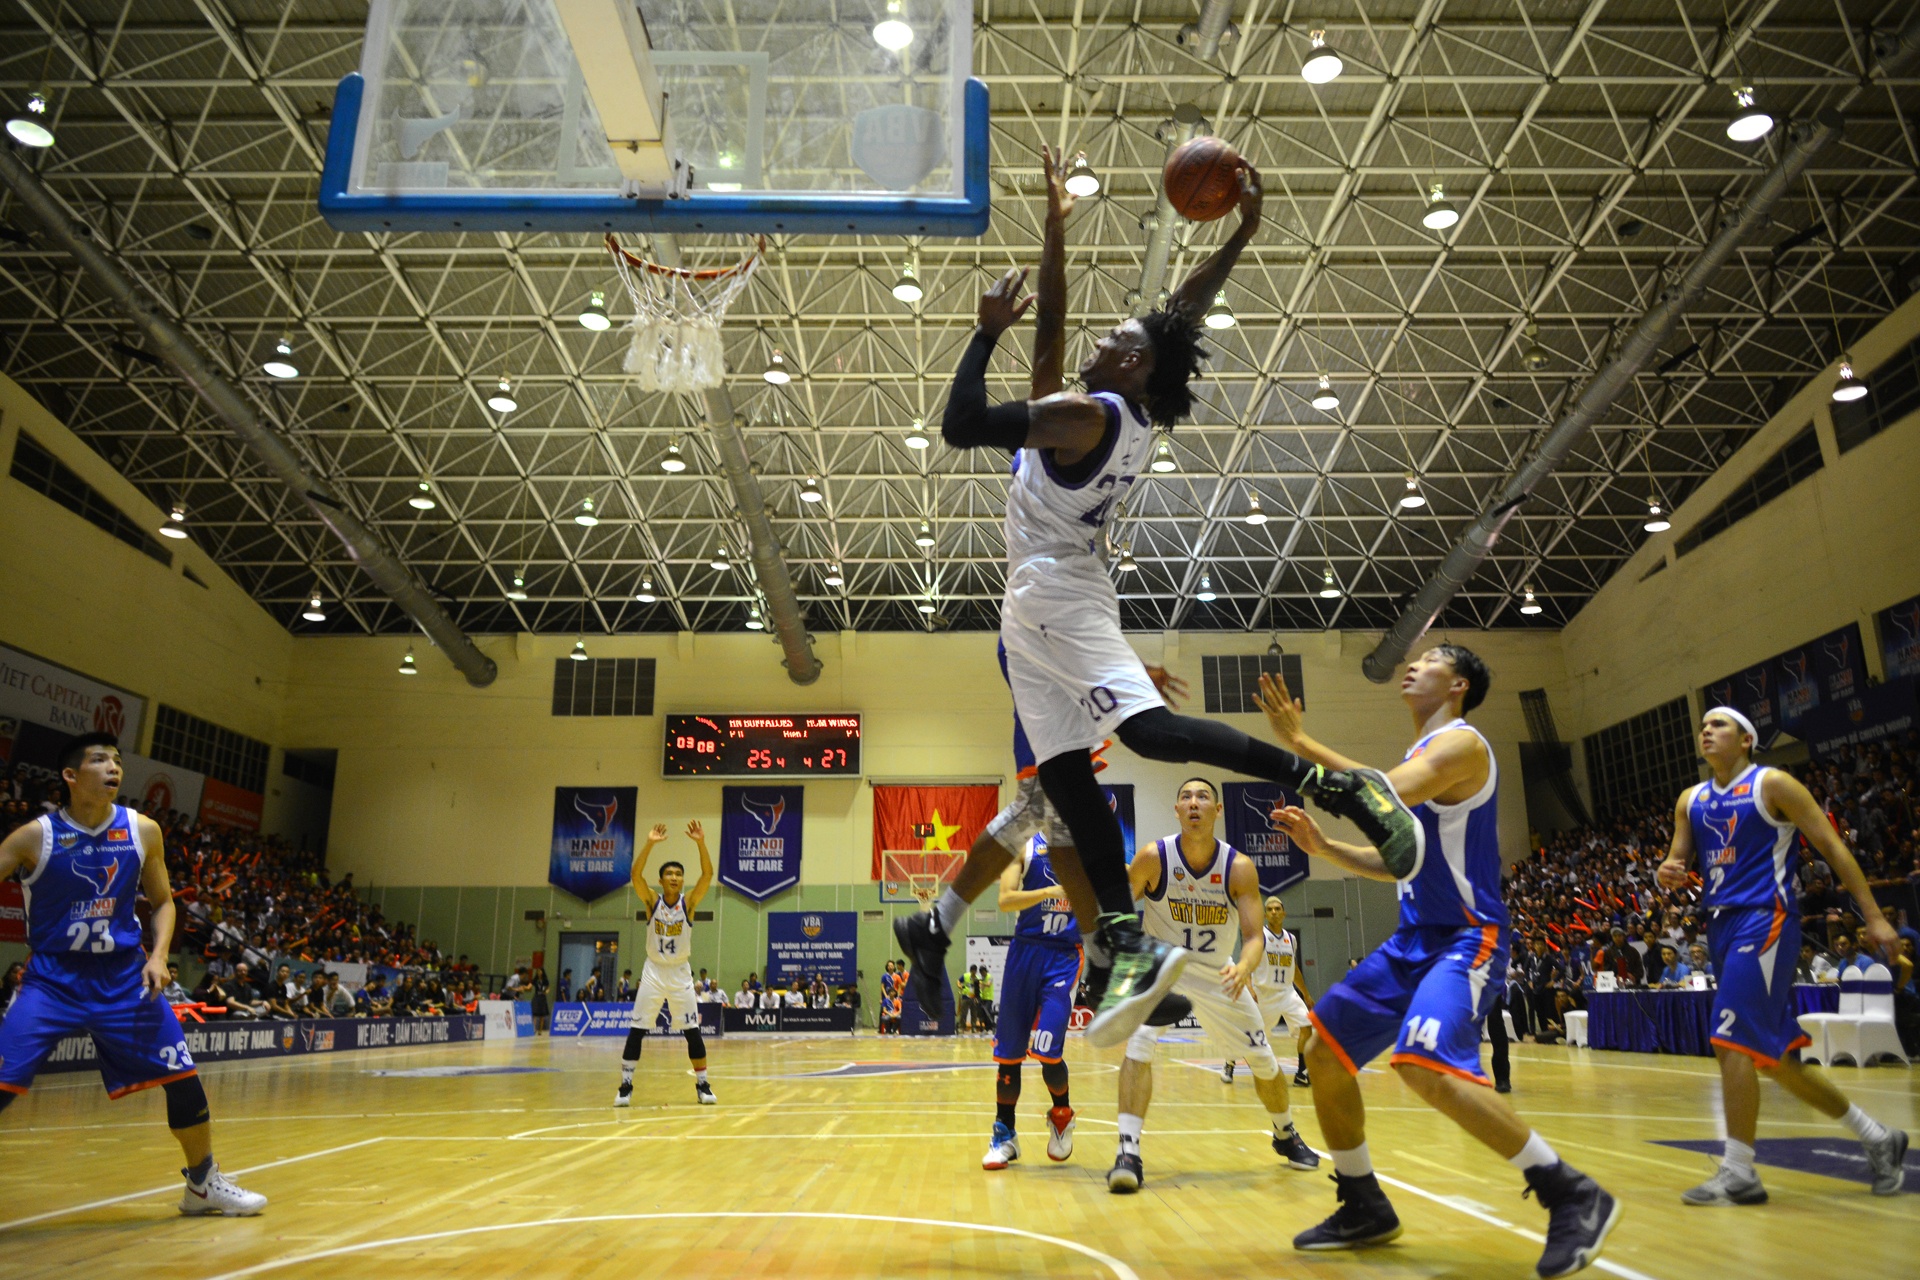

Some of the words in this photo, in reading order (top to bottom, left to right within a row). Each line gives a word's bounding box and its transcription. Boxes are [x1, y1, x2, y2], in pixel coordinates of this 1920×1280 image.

[31, 675, 92, 713] CAPITAL
[1080, 686, 1118, 721] 20
[49, 705, 88, 733] BANK
[677, 736, 694, 749] 03
[697, 740, 715, 753] 08
[747, 749, 772, 769] 25
[776, 757, 785, 768] 4
[803, 757, 812, 768] 4
[821, 749, 846, 768] 27
[60, 832, 78, 840] VBA
[921, 824, 933, 836] 14
[571, 839, 614, 850] HANOI
[740, 838, 783, 850] HANOI
[1246, 833, 1288, 845] HANOI
[96, 844, 136, 854] vinaphone
[570, 850, 614, 858] BUFFALOES
[739, 850, 783, 858] BUFFALOES
[570, 860, 586, 872] WE
[587, 860, 614, 873] DARE
[739, 859, 755, 872] WE
[756, 859, 783, 872] DARE
[1264, 855, 1290, 867] DARE
[1709, 866, 1725, 895] 2
[72, 898, 116, 914] HANOI
[1169, 901, 1193, 923] CITY
[1196, 904, 1228, 926] WINGS
[803, 916, 821, 927] VBA
[1041, 912, 1069, 936] 10
[67, 919, 115, 953] 23
[1182, 928, 1216, 953] 12
[659, 938, 676, 954] 14
[1274, 968, 1286, 984] 11
[559, 1011, 581, 1020] VUG
[685, 1012, 697, 1024] 14
[1716, 1008, 1736, 1037] 2
[357, 1024, 369, 1046] WE
[370, 1024, 389, 1046] DARE
[1034, 1029, 1053, 1053] 10
[1245, 1030, 1267, 1047] 12
[1406, 1015, 1441, 1051] 14
[210, 1031, 226, 1056] TẠI
[229, 1027, 249, 1055] VIỆT
[159, 1040, 194, 1071] 23
